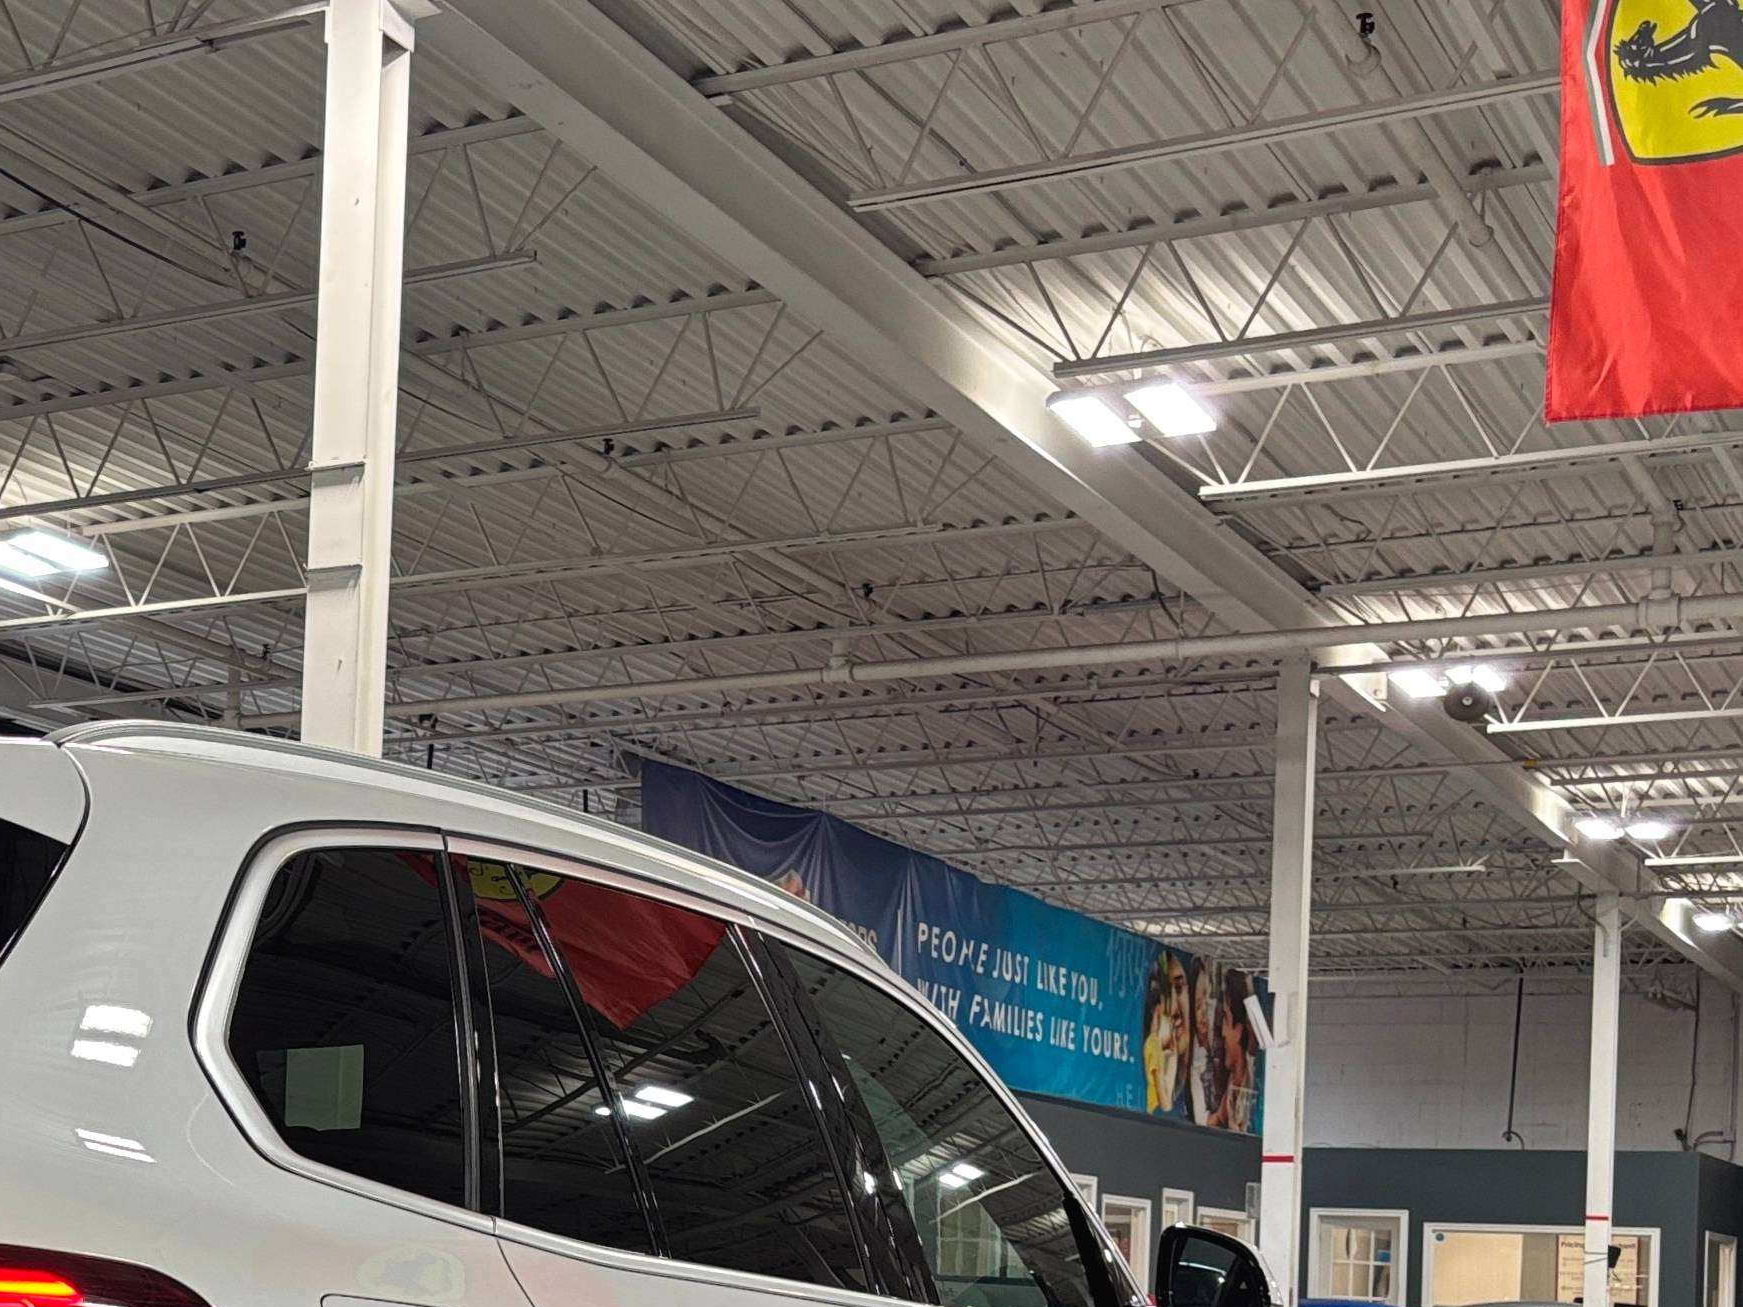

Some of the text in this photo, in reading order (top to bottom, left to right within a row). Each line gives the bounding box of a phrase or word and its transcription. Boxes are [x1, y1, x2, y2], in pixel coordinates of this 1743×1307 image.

[992, 947, 1030, 986] JUST
[1036, 959, 1068, 997] LIKE
[916, 977, 1136, 1064] WITH FAMILIES LIKE YOURS.
